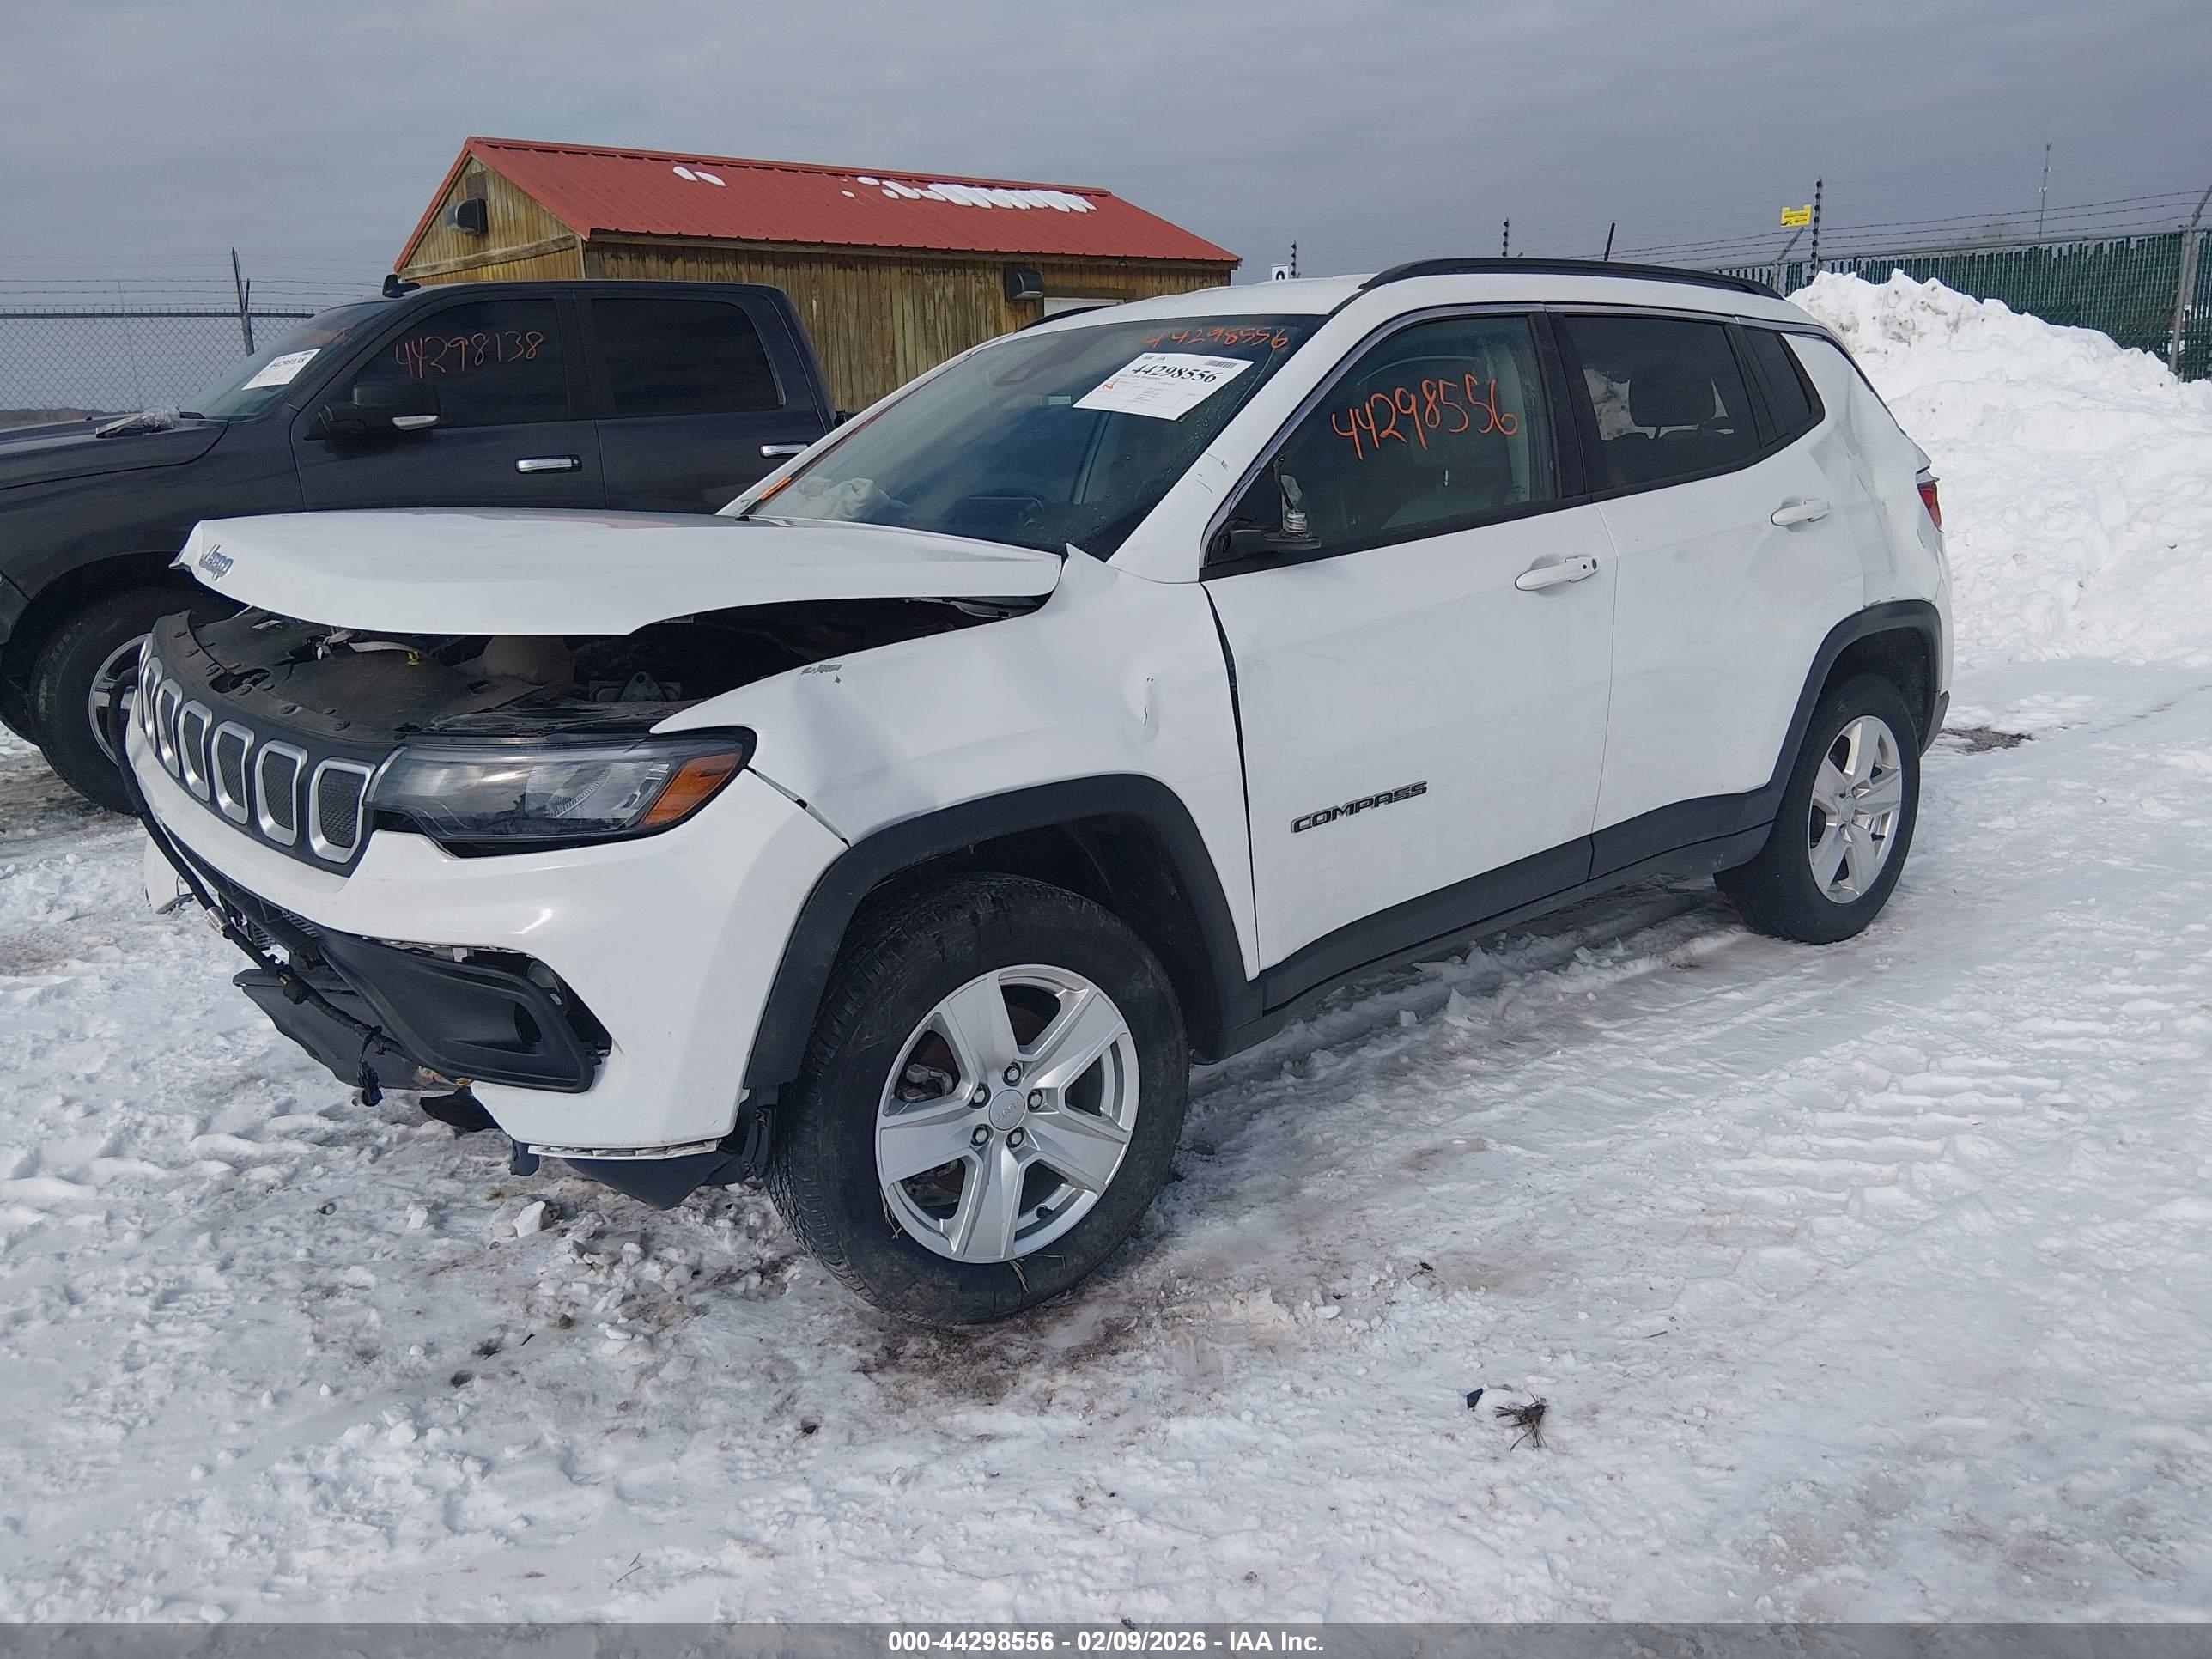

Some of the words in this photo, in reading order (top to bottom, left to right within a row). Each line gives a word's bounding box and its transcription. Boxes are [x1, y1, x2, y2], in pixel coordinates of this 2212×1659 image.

[395, 331, 545, 379] 44298138
[1142, 326, 1288, 349] 44298556
[1132, 363, 1224, 384] 44298556
[1332, 372, 1518, 461] 44298556
[1291, 780, 1428, 834] COMPASS
